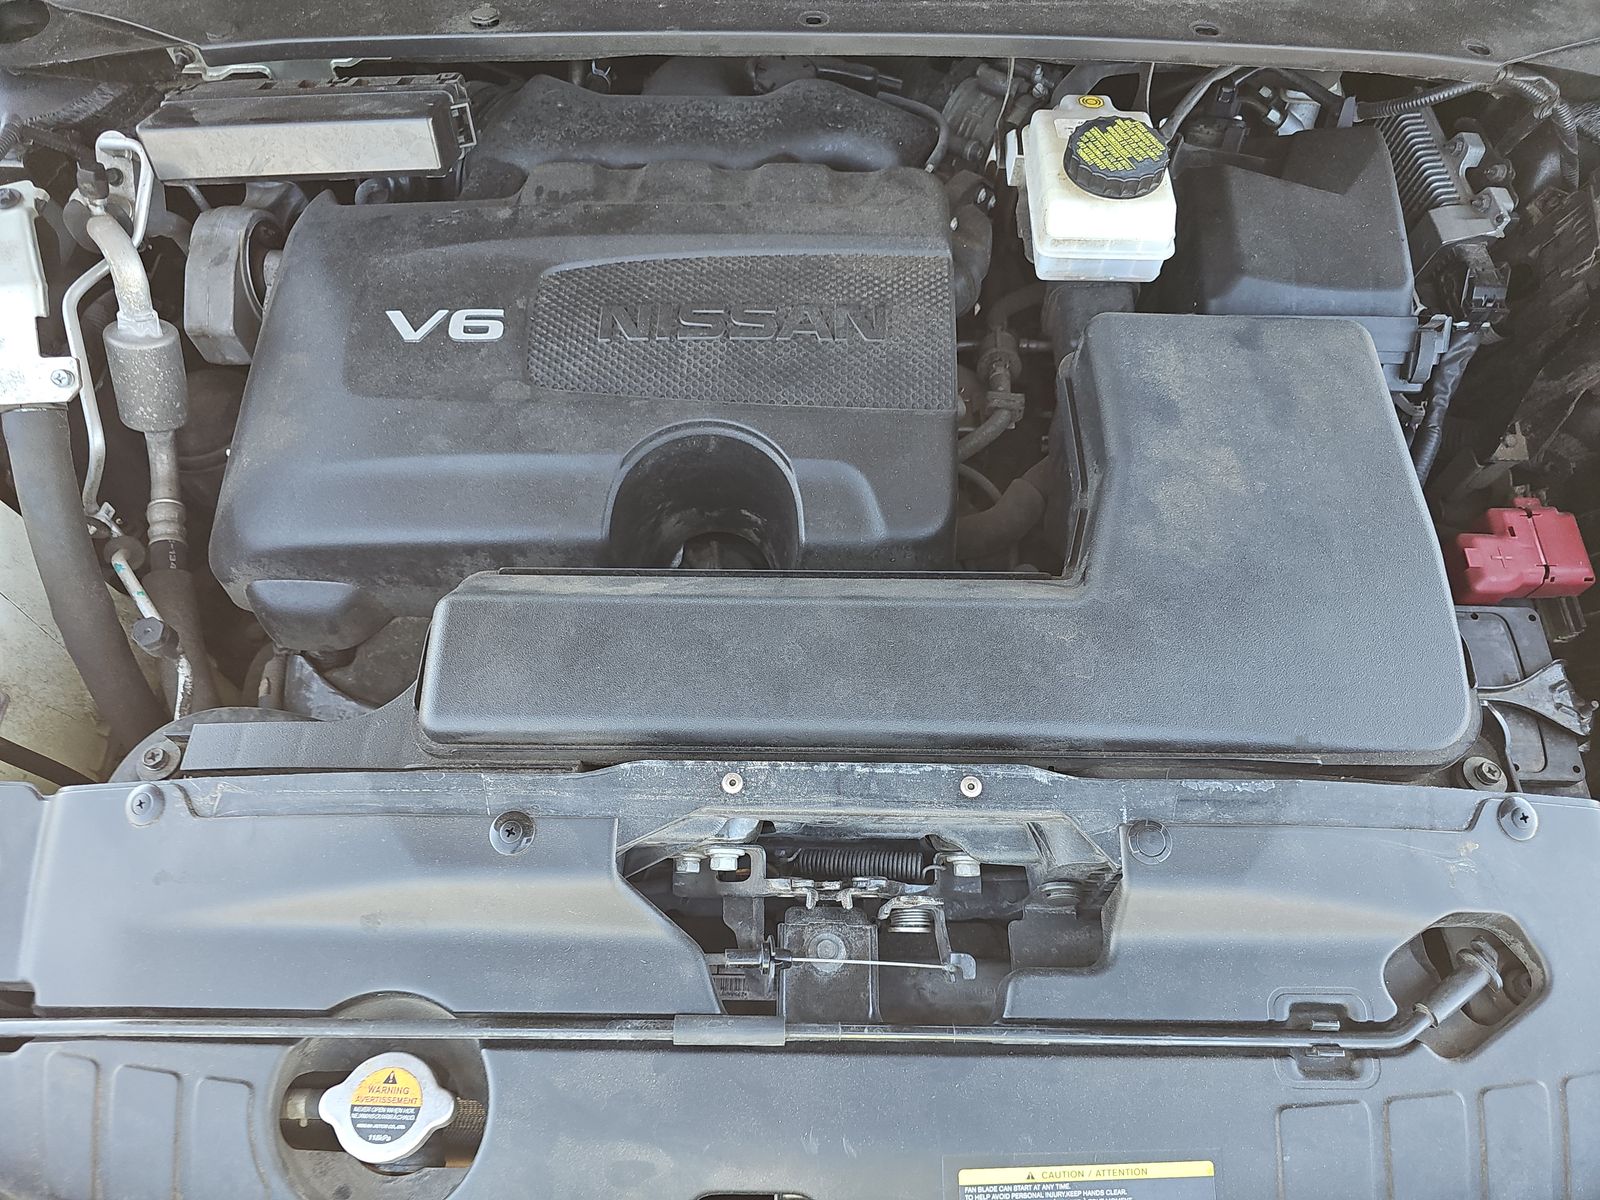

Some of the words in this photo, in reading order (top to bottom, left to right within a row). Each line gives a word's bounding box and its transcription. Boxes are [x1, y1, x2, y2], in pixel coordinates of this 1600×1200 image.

[385, 308, 505, 343] V6
[597, 302, 887, 343] NISSAN
[367, 1085, 410, 1095] WARNING
[354, 1095, 418, 1104] AVERTISSEMENT
[1041, 1170, 1084, 1179] CAUTION
[1095, 1168, 1148, 1177] ATTENTION
[1055, 1182, 1071, 1190] TIME.
[1105, 1188, 1128, 1196] CLEAR.
